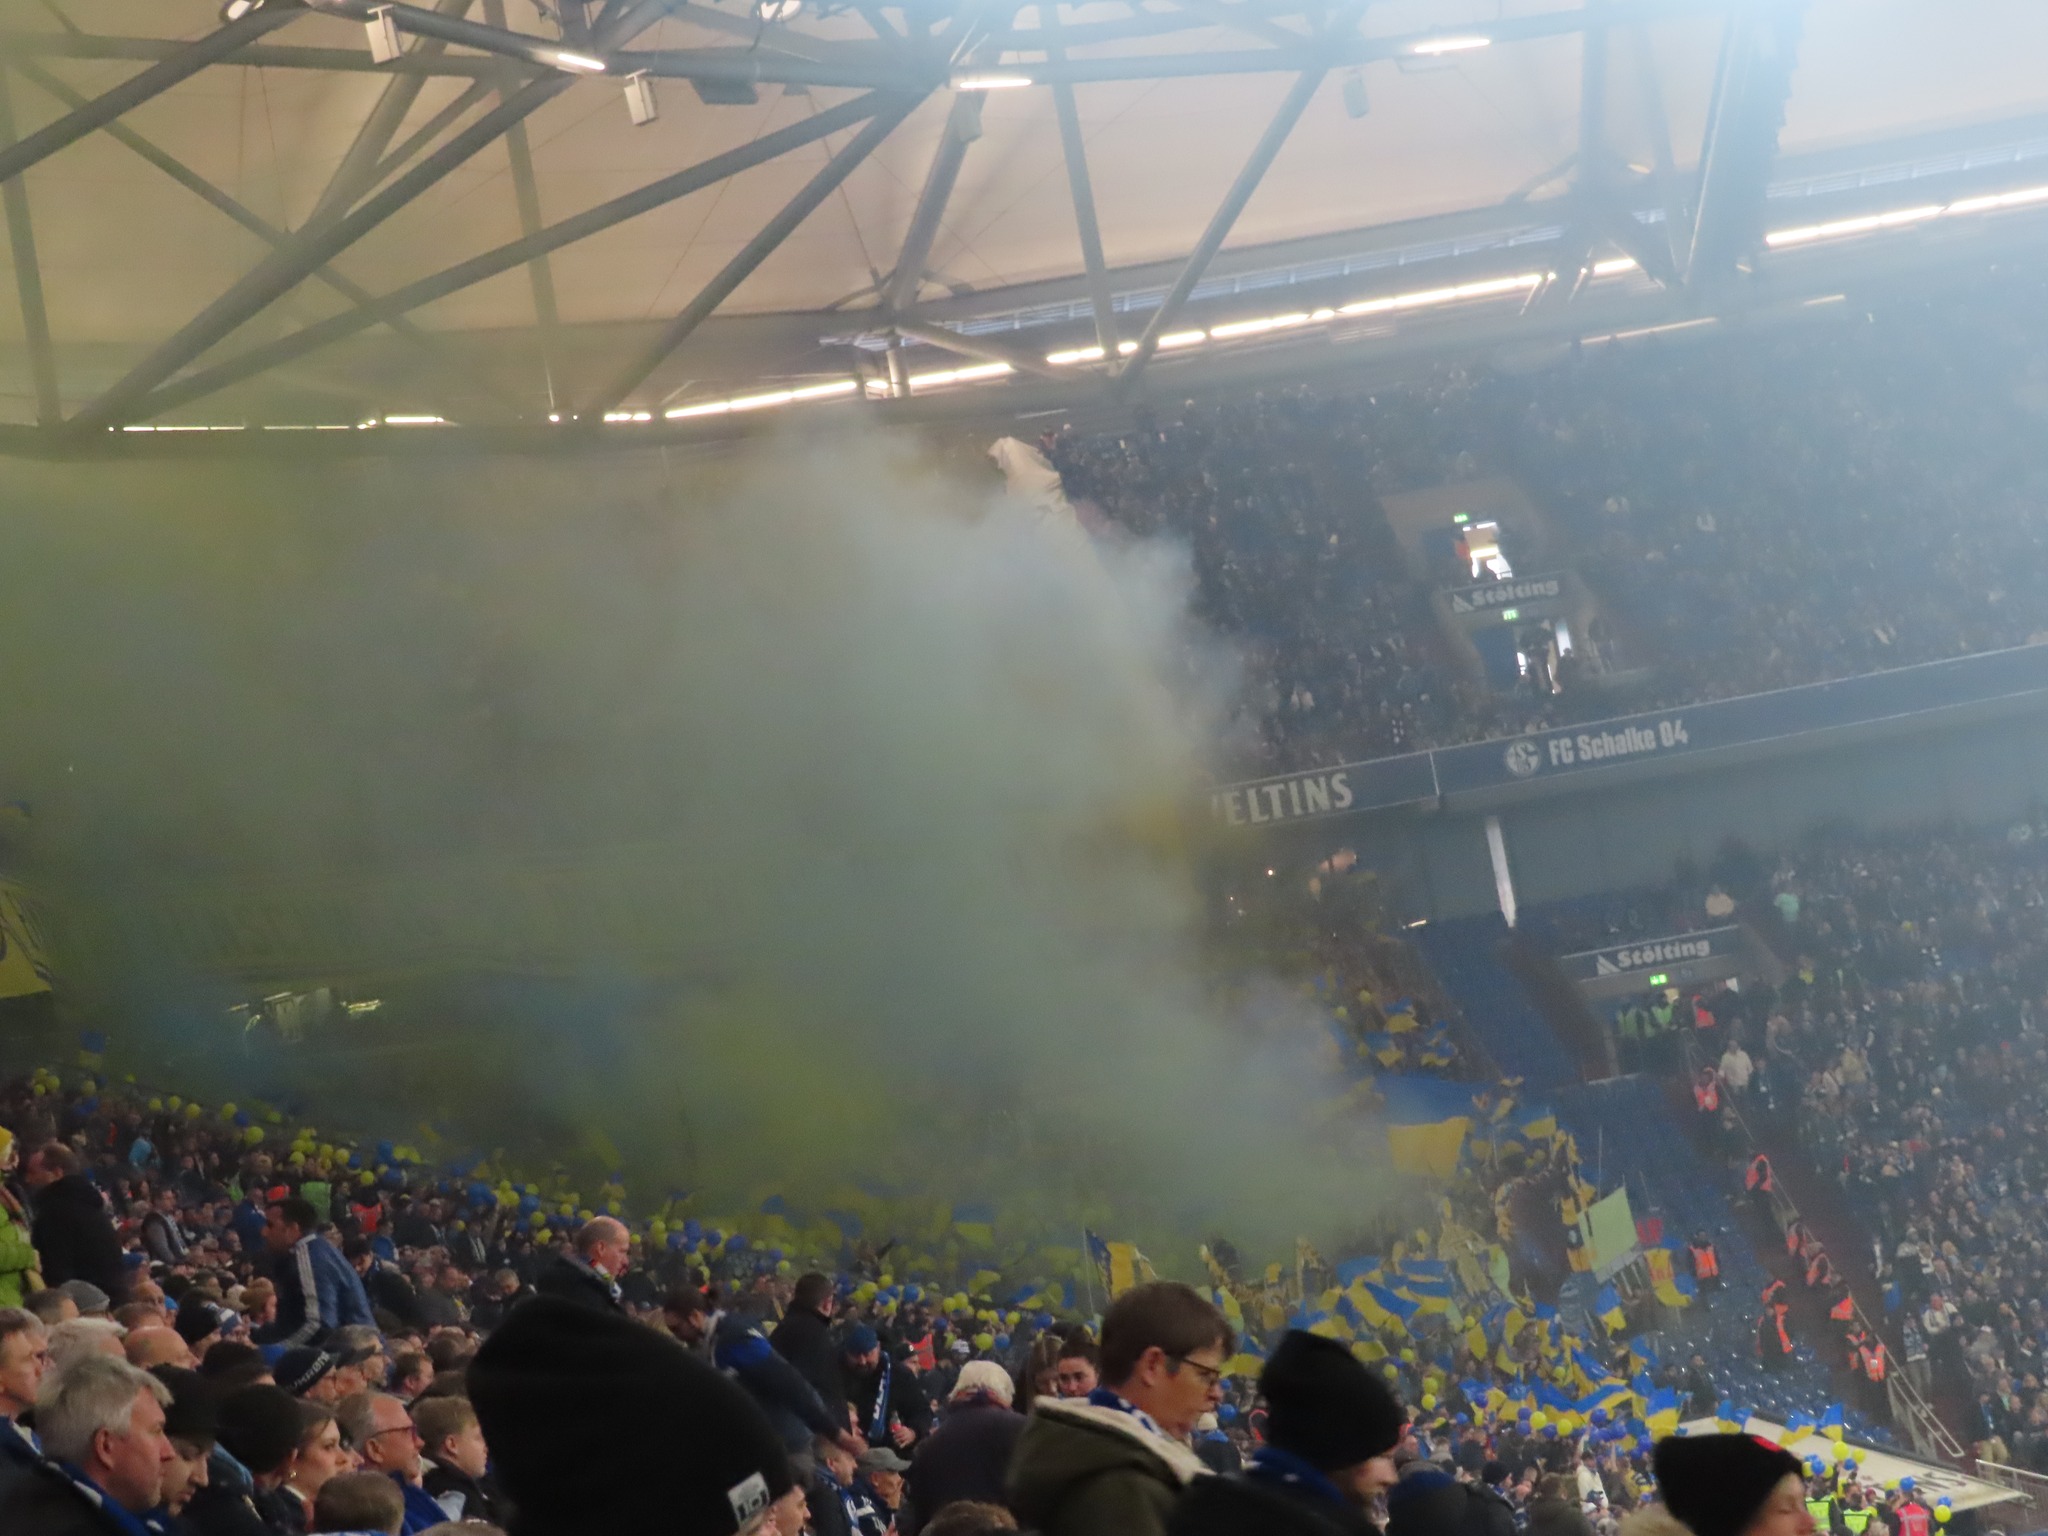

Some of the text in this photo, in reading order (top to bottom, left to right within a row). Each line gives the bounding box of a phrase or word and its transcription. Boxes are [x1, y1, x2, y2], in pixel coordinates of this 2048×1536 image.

[1548, 737, 1575, 766] FC
[1576, 726, 1657, 761] Schalke
[1659, 719, 1689, 748] 04
[1617, 939, 1711, 968] Stölting
